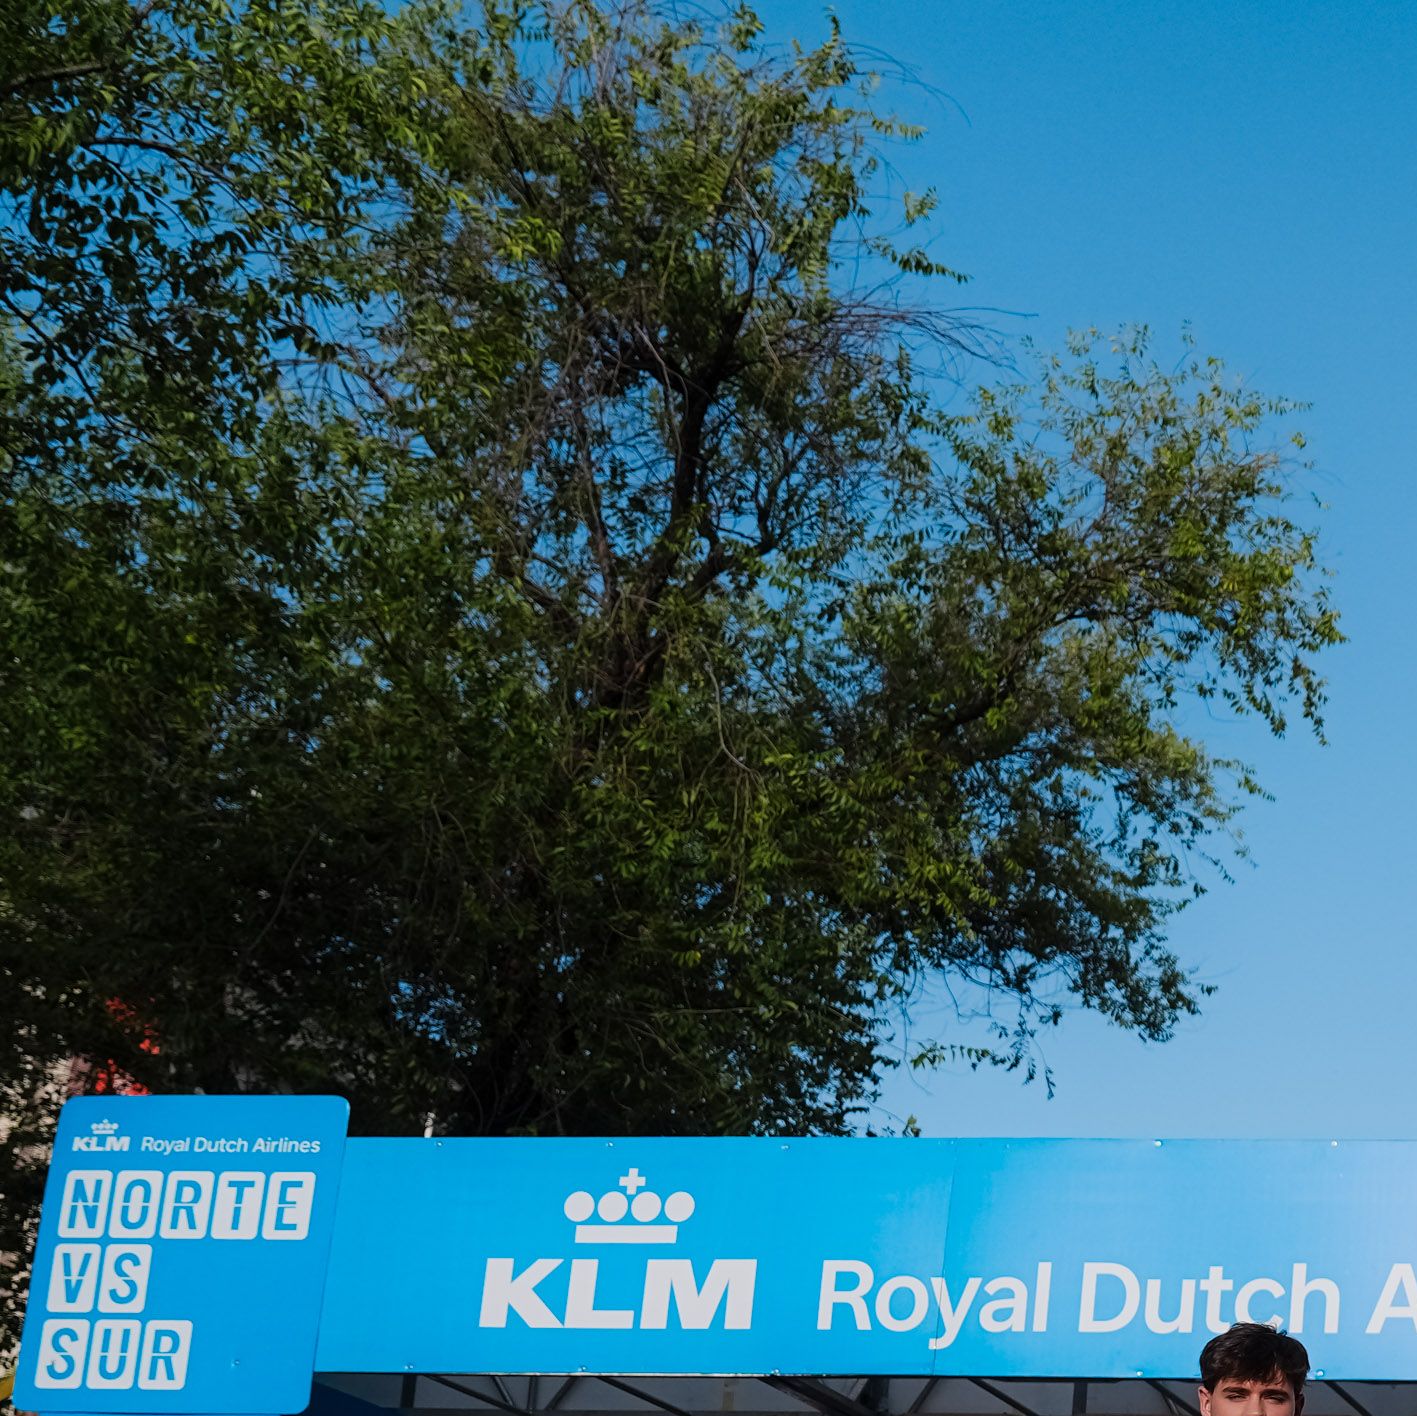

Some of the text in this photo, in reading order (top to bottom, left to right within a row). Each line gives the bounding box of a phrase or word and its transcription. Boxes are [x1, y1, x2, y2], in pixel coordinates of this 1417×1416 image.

[72, 1136, 321, 1155] KLM Royal Dutch Airlines
[66, 1173, 313, 1236] NORTE
[58, 1247, 148, 1309] VS
[479, 1257, 757, 1330] KLM
[817, 1259, 1051, 1350] Royal
[1077, 1261, 1340, 1336] Dutch
[42, 1322, 189, 1386] SUR
